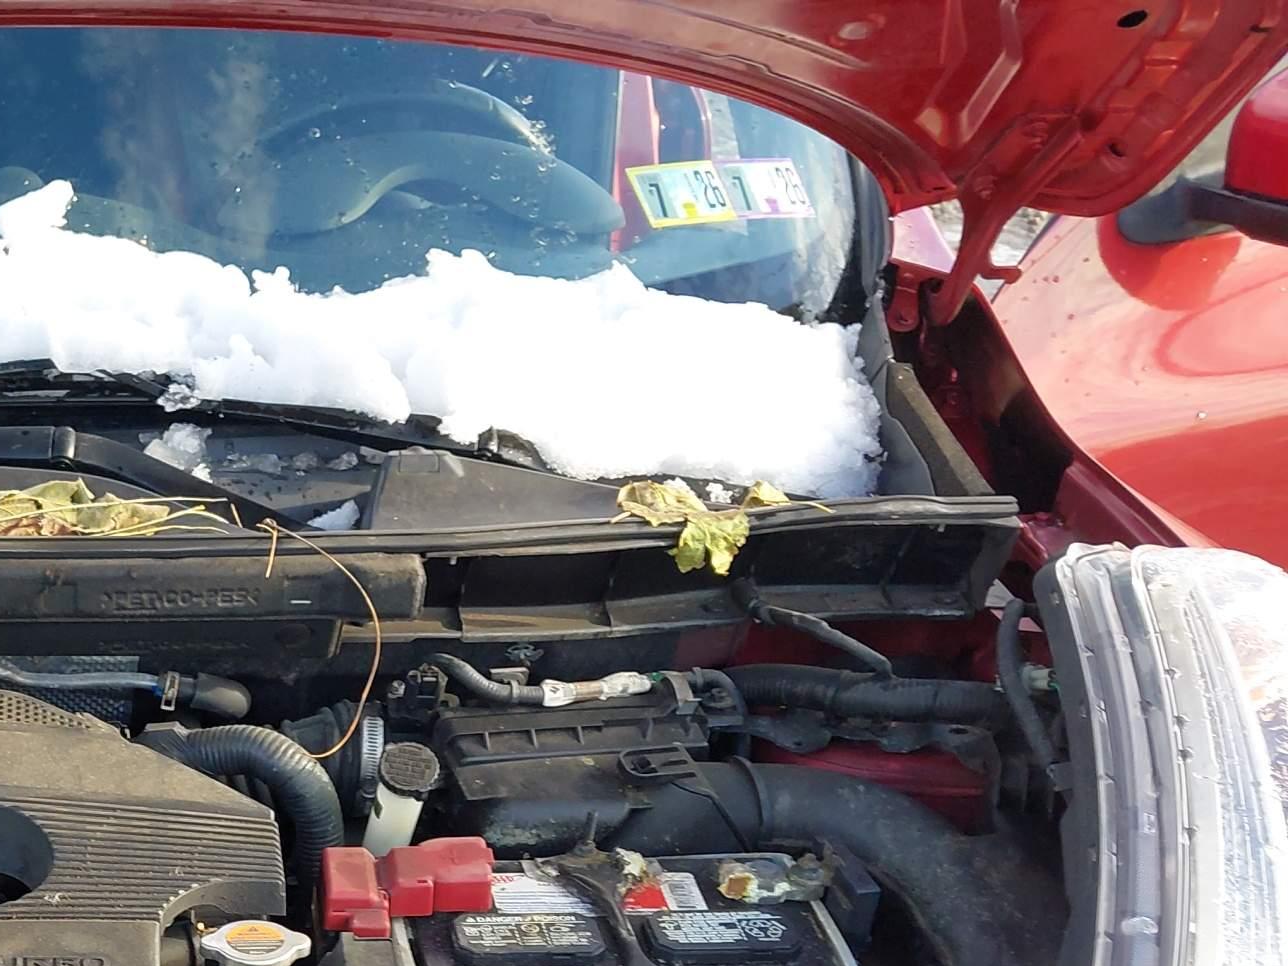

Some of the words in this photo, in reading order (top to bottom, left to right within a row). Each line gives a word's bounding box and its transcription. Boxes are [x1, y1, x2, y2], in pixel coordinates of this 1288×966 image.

[648, 183, 669, 217] 7
[693, 170, 727, 208] 26
[732, 176, 753, 211] 7
